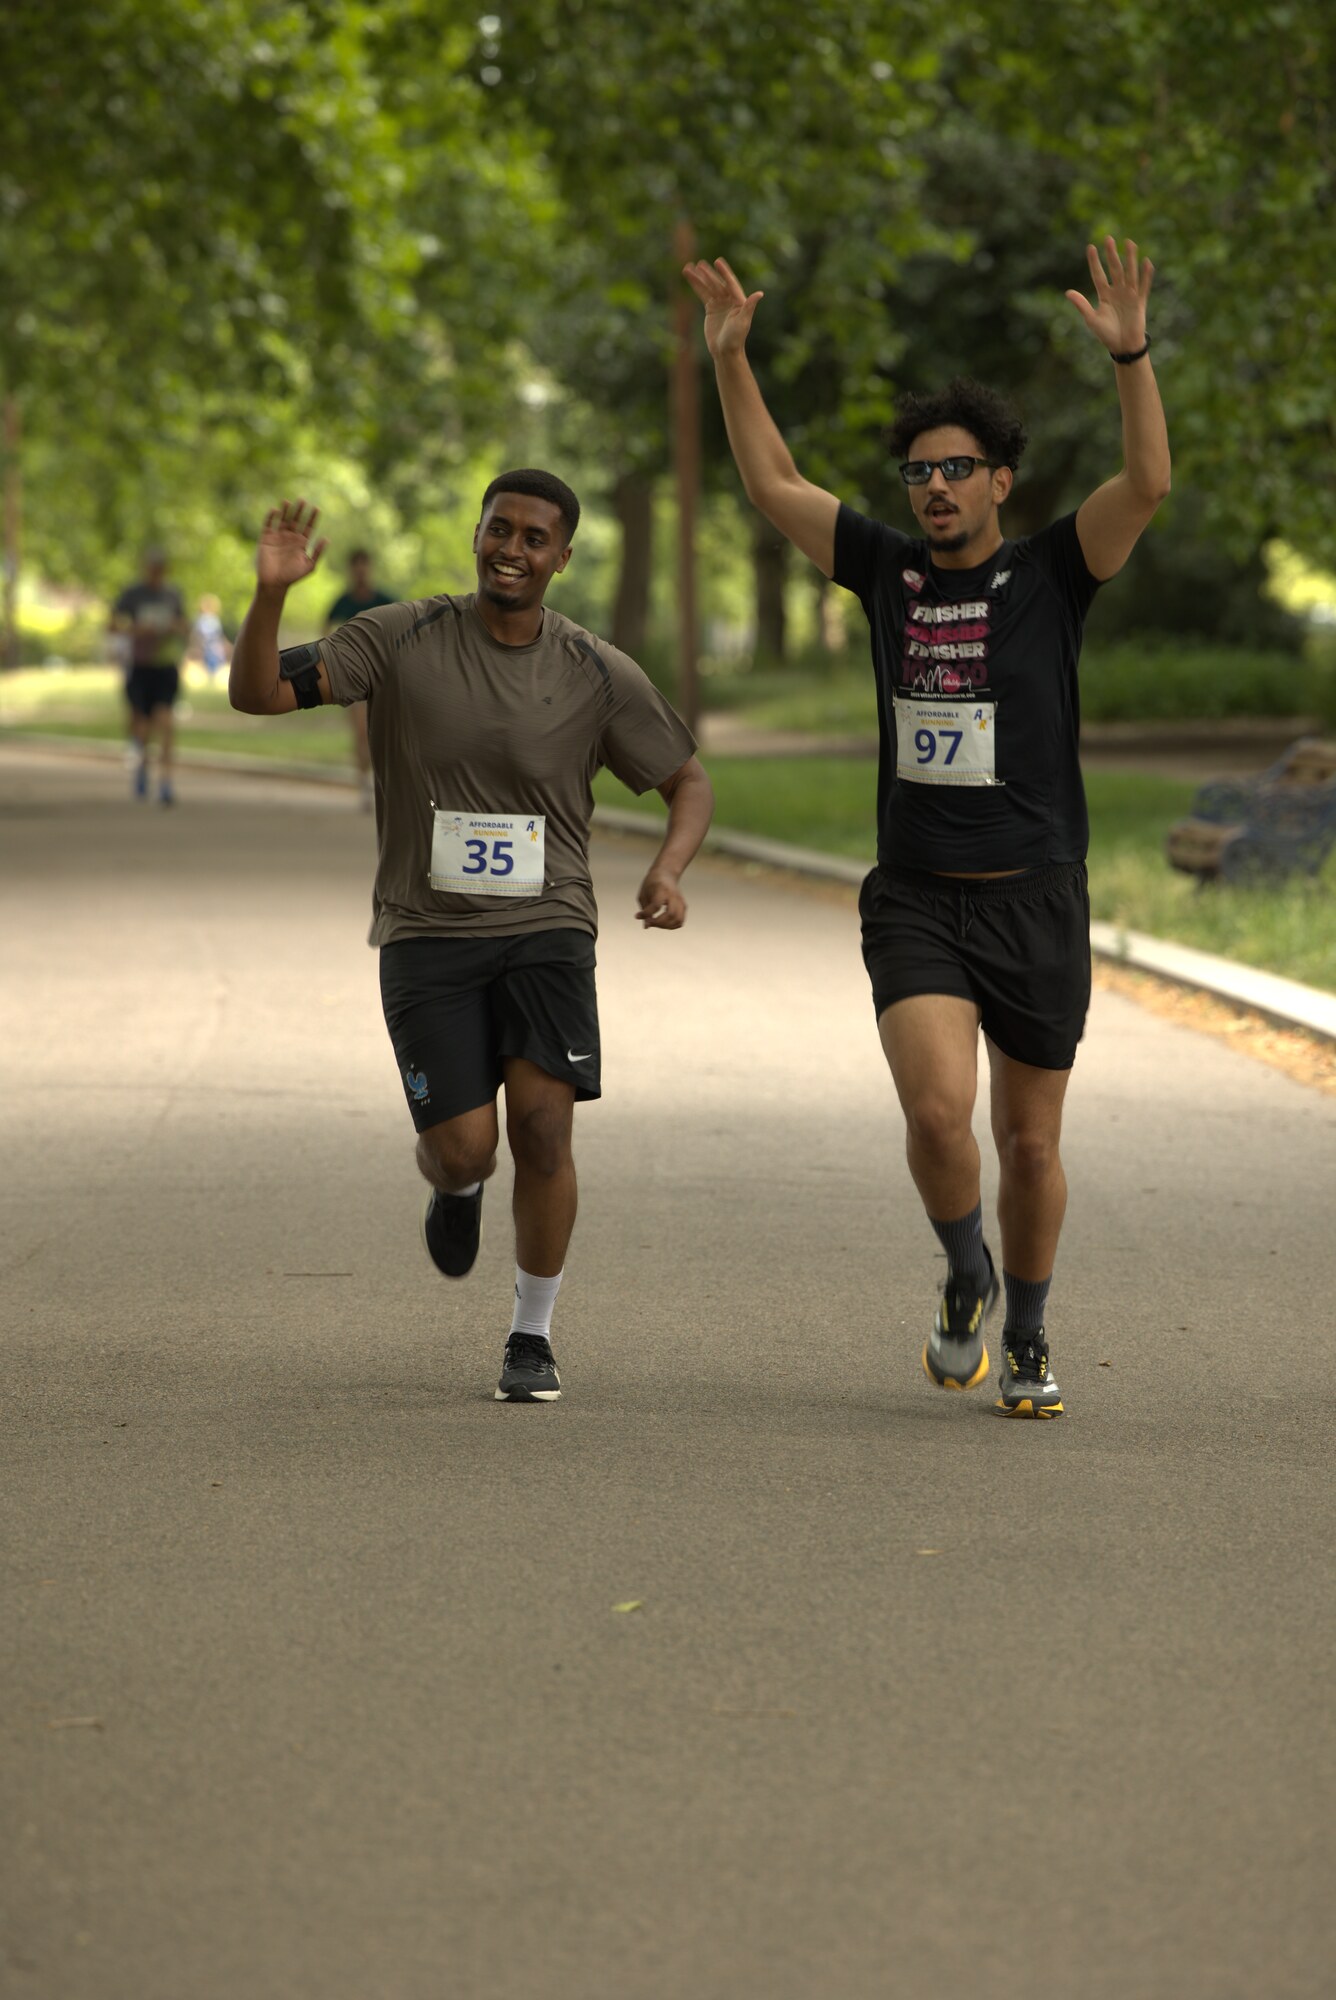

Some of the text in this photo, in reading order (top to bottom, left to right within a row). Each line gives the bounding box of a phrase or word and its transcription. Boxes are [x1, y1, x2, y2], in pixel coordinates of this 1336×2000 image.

[912, 602, 989, 623] FINISHER
[916, 710, 959, 718] AFFORDABLE
[920, 719, 955, 727] RUNNING
[914, 728, 964, 766] 97
[469, 821, 513, 829] AFFORDABLE
[462, 839, 514, 875] 35
